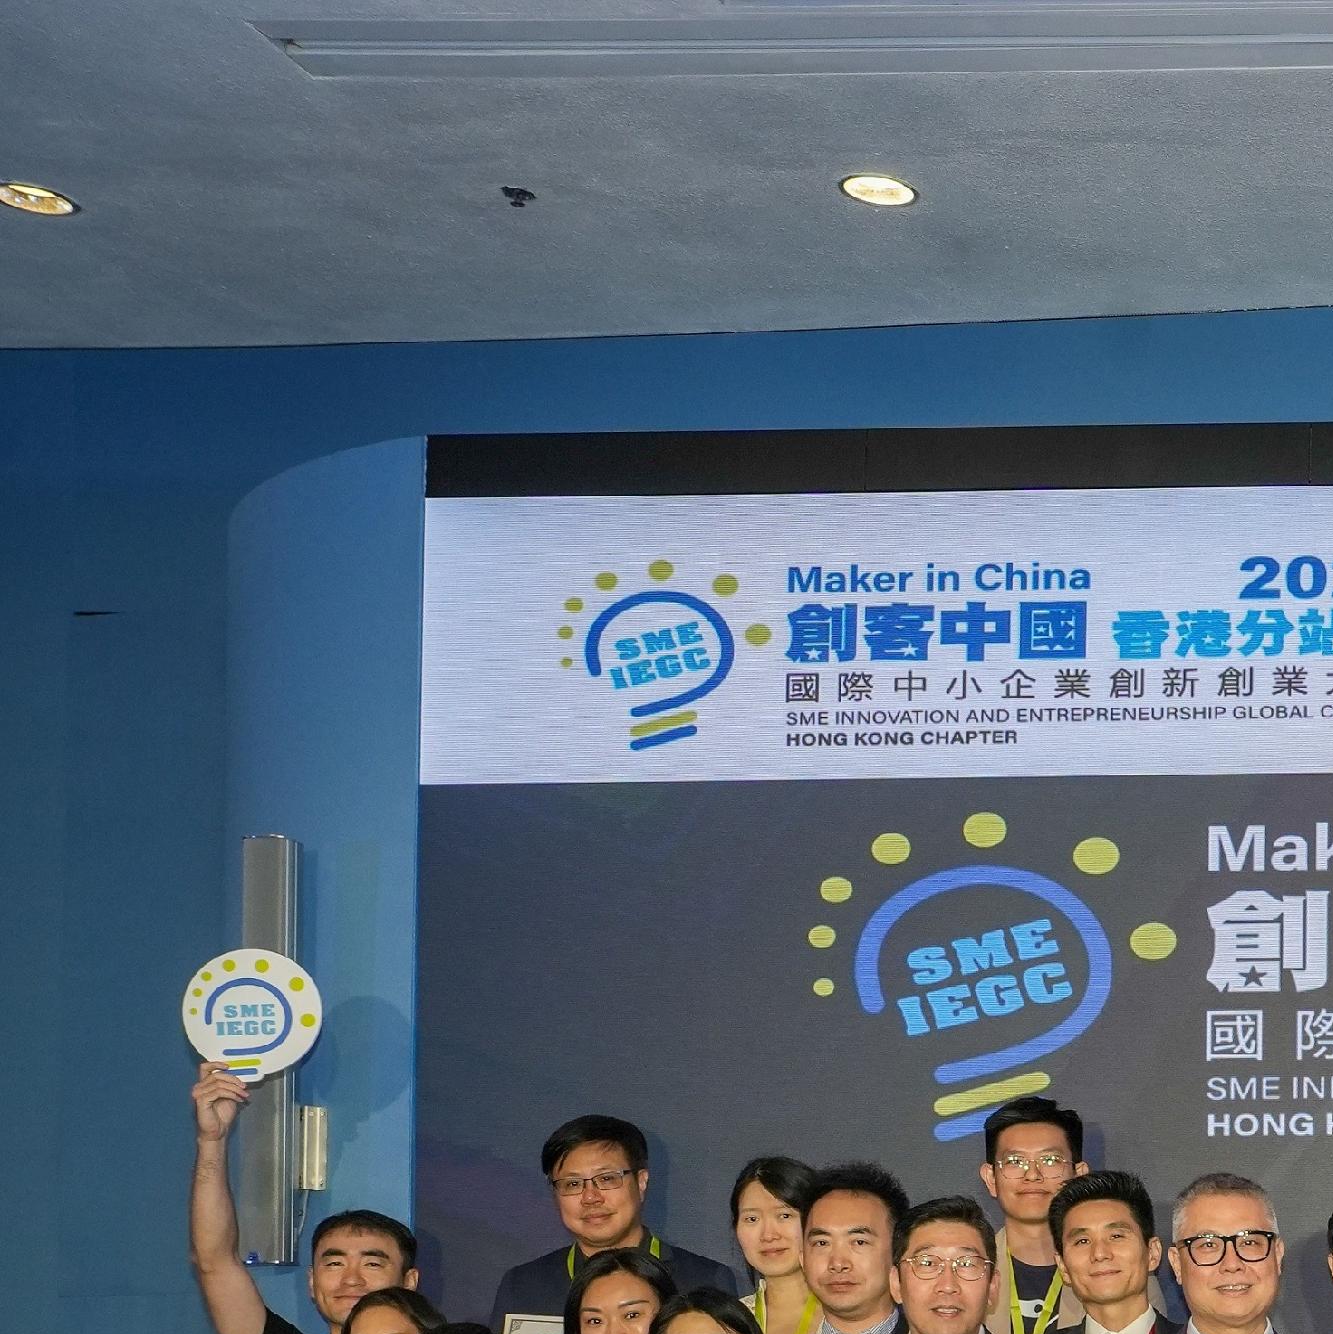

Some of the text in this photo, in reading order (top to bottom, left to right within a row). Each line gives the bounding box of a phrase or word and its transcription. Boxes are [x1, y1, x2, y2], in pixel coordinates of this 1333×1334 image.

[787, 563, 1091, 594] Maker in China
[615, 622, 703, 660] SME
[787, 602, 1088, 662] 創客中國
[609, 648, 711, 689] IEGC
[787, 711, 829, 725] SME
[836, 709, 959, 725] INNOVATION
[966, 709, 1009, 723] AND
[1016, 705, 1226, 723] ENTREPRENEURSHIP
[1233, 705, 1313, 719] GLOBAL
[787, 730, 1017, 747] HONG KONG CHAPTER
[907, 919, 1060, 985] SME
[223, 1004, 275, 1018] SME
[897, 961, 1073, 1036] IEGC
[216, 1020, 277, 1036] IEGC
[1206, 1076, 1281, 1101] SME
[1207, 1112, 1314, 1137] HONG
